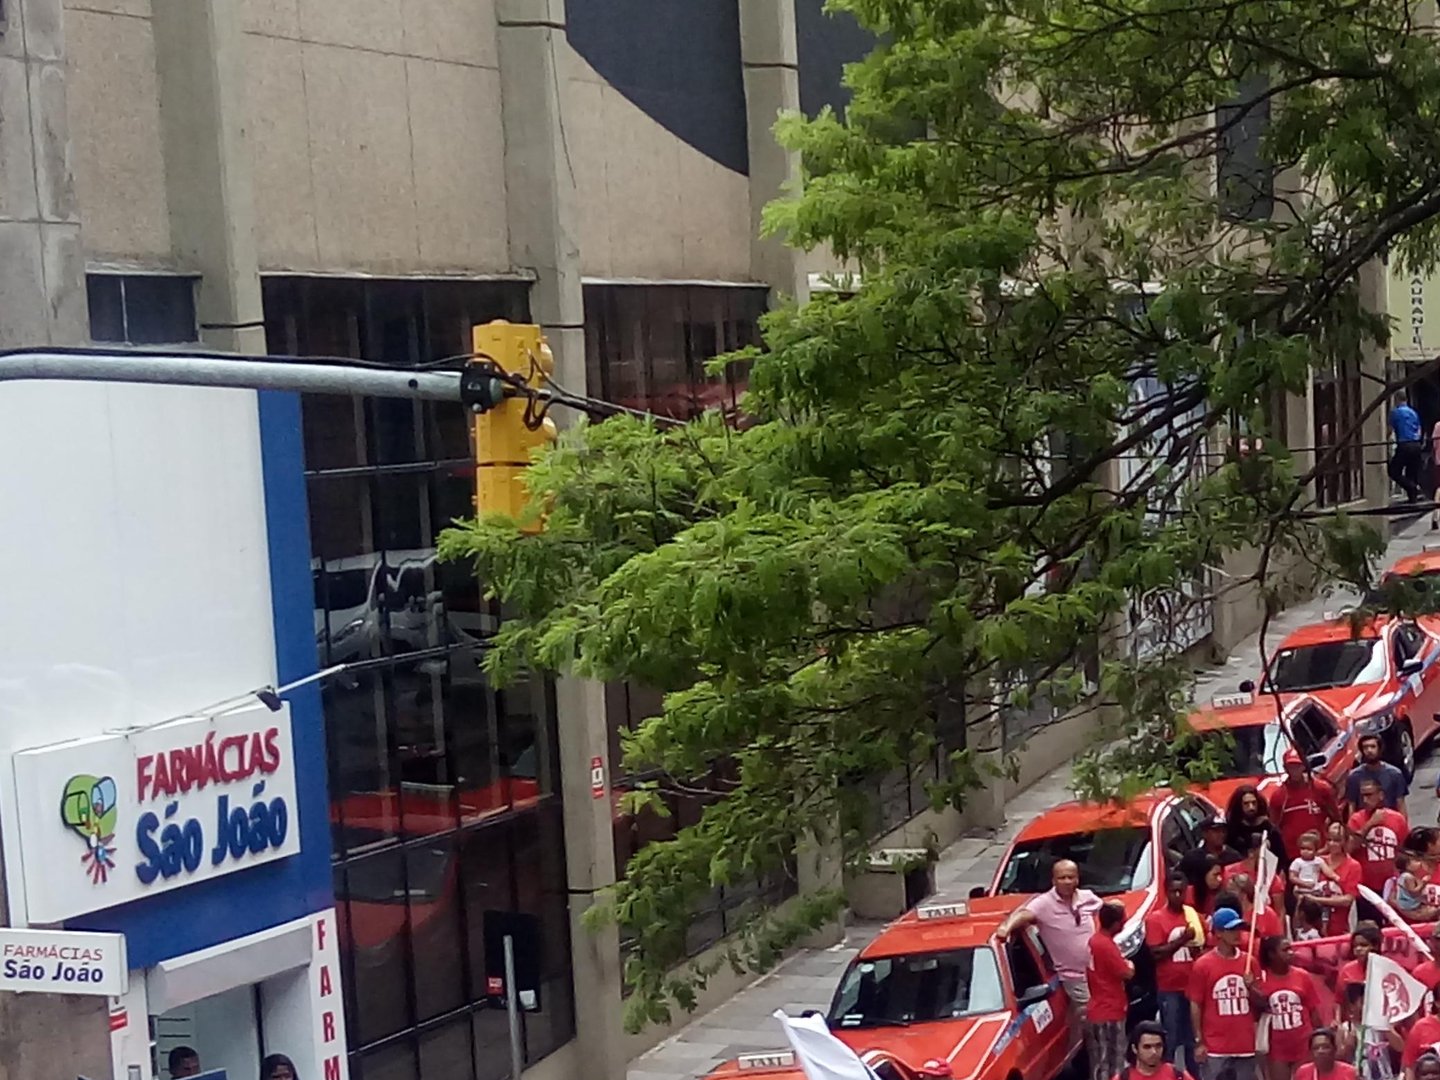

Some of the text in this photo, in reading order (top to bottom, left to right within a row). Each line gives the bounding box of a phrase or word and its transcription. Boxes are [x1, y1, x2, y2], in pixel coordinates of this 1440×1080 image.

[137, 727, 280, 804] FARMÁCIAS
[136, 780, 288, 884] São João
[926, 907, 957, 918] TAXI
[3, 944, 104, 961] FARMÁCIAS
[3, 959, 104, 983] São João
[747, 1056, 783, 1068] TAXI
